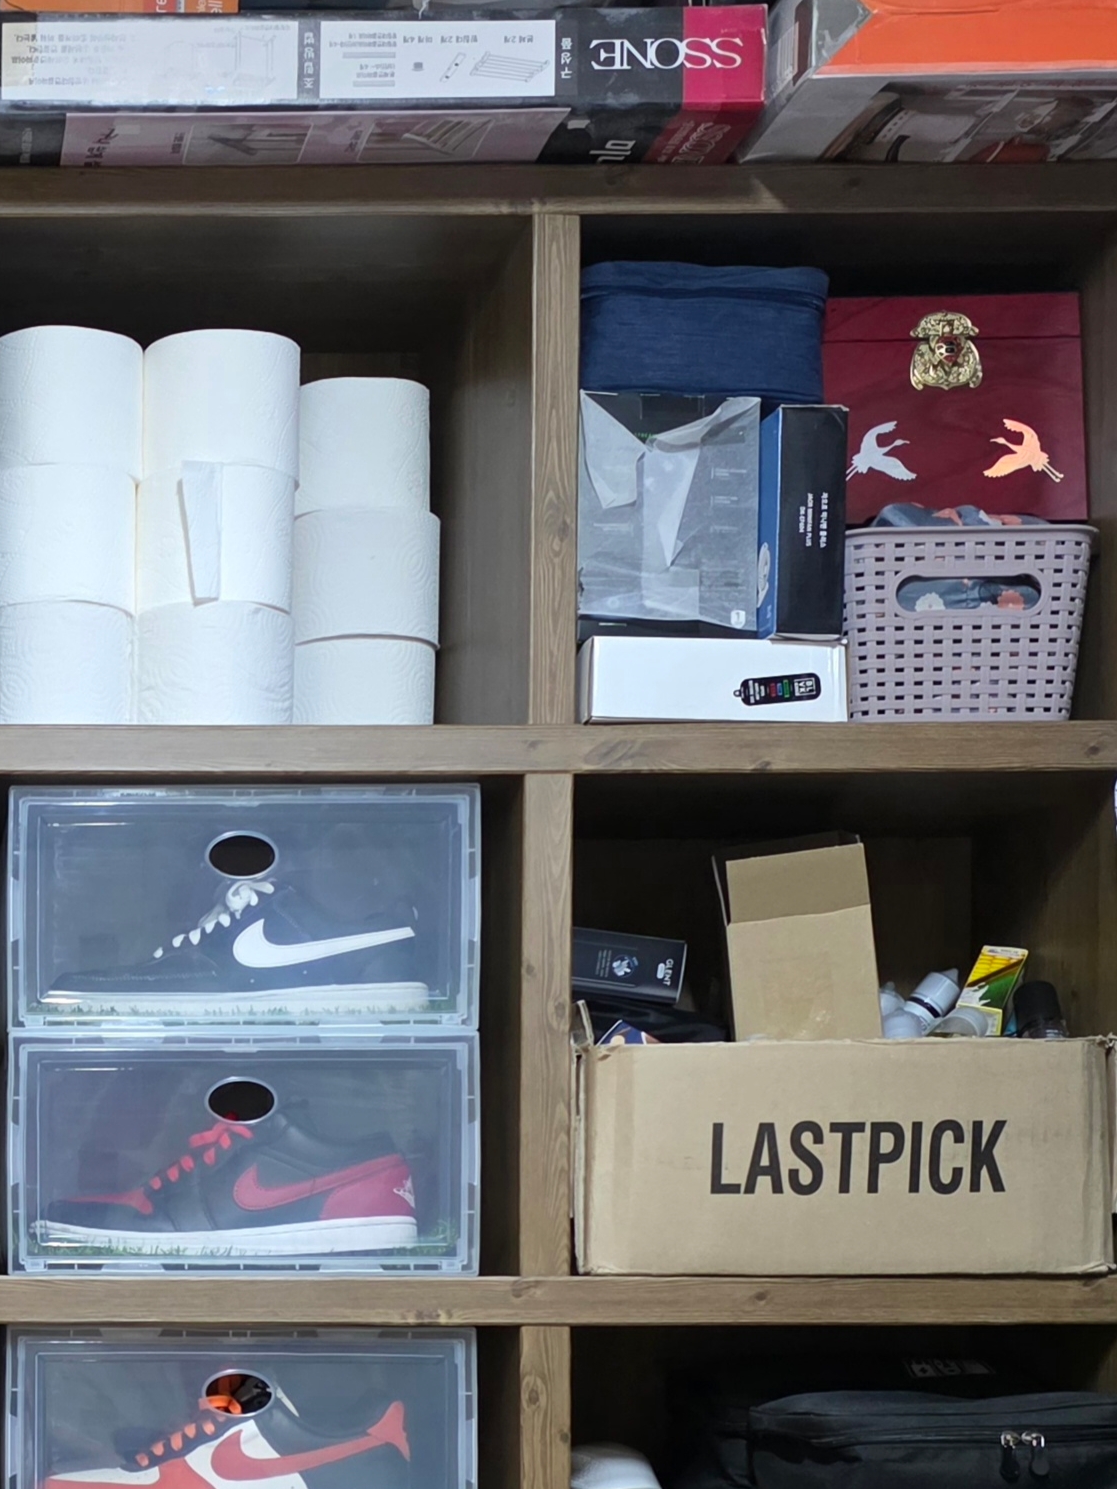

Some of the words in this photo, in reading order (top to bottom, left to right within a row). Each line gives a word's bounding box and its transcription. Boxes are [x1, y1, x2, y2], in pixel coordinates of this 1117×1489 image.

[589, 38, 743, 70] SSONE
[663, 959, 674, 986] GLENT
[710, 1119, 1008, 1195] LASTPICK
